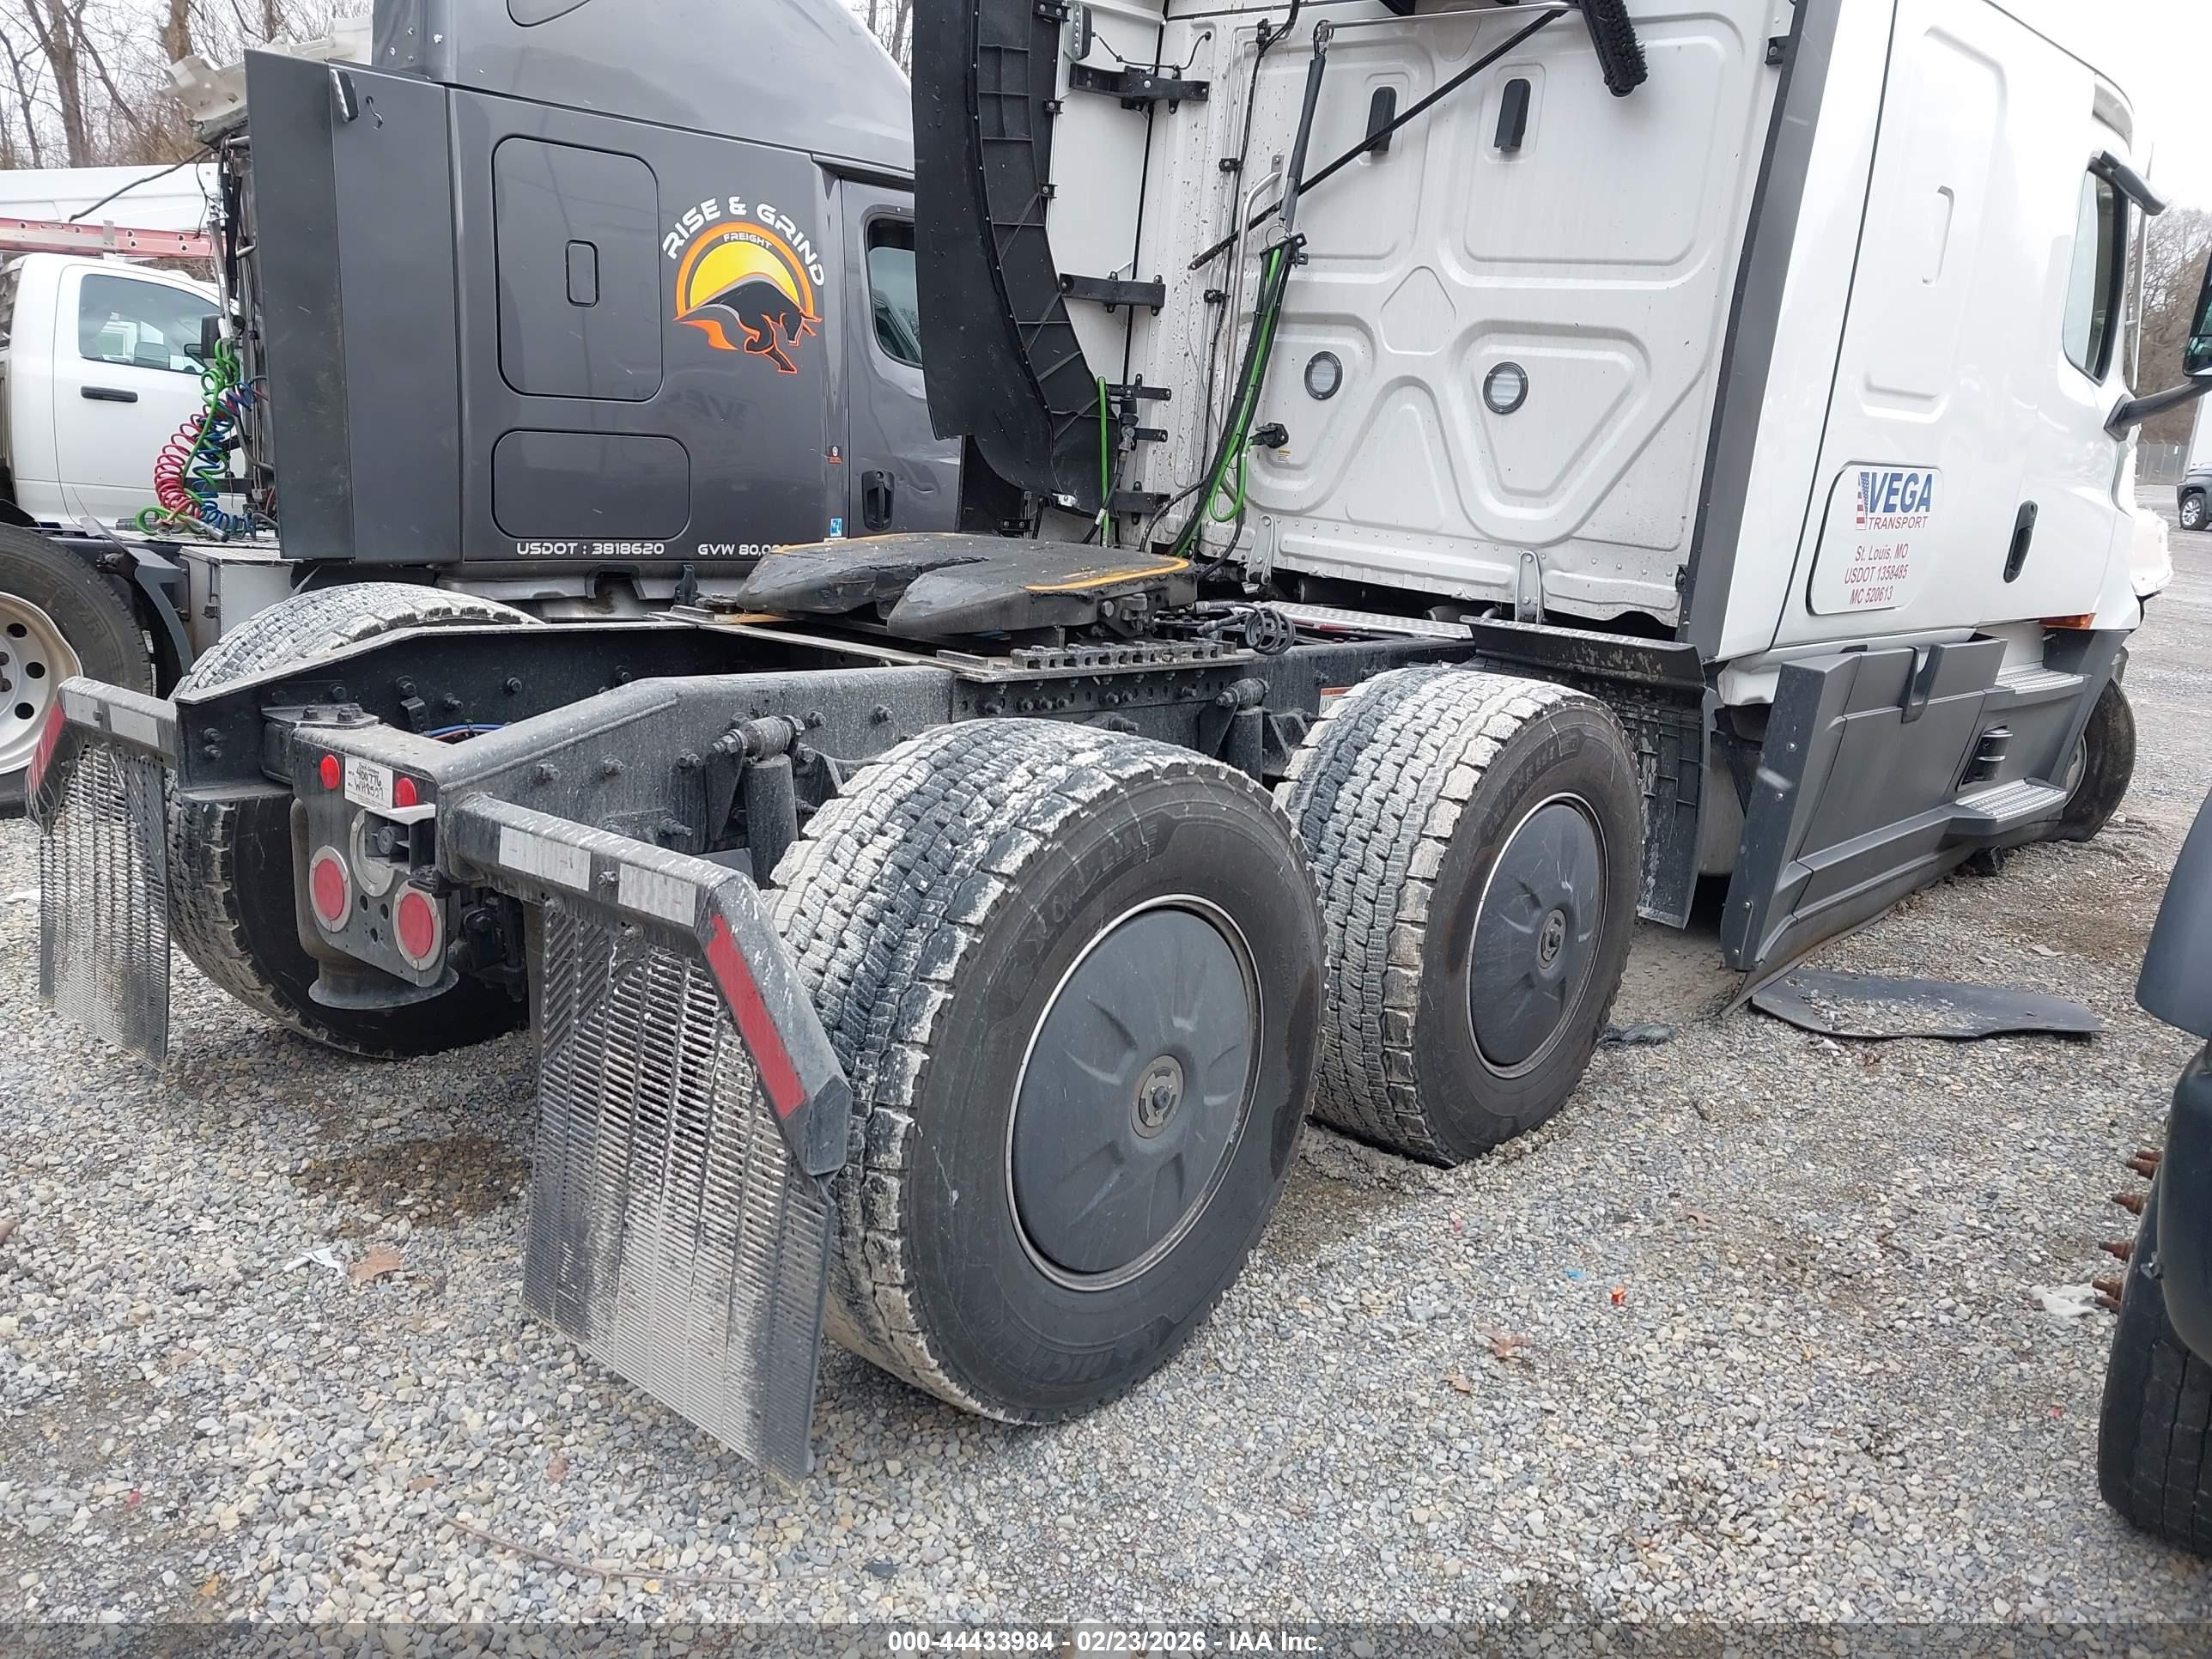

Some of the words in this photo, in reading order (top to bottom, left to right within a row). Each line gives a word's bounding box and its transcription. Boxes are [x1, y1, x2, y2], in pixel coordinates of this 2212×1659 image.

[662, 198, 721, 260] RISE
[728, 196, 747, 216] &
[757, 203, 825, 286] GRIND
[723, 233, 772, 249] FREIGHT
[1868, 471, 1933, 514] VEGA
[1869, 515, 1929, 531] TRANSPORT
[516, 542, 578, 556] USDOT
[591, 542, 665, 556] 3818620
[697, 544, 735, 556] GVW
[1855, 544, 1866, 562] St.
[1868, 544, 1892, 562] Louis,
[1894, 543, 1909, 560] MO
[1844, 566, 1876, 584] USDOT
[1877, 563, 1909, 581] 1358485
[1849, 587, 1864, 605] MC
[1865, 585, 1893, 603] 520613
